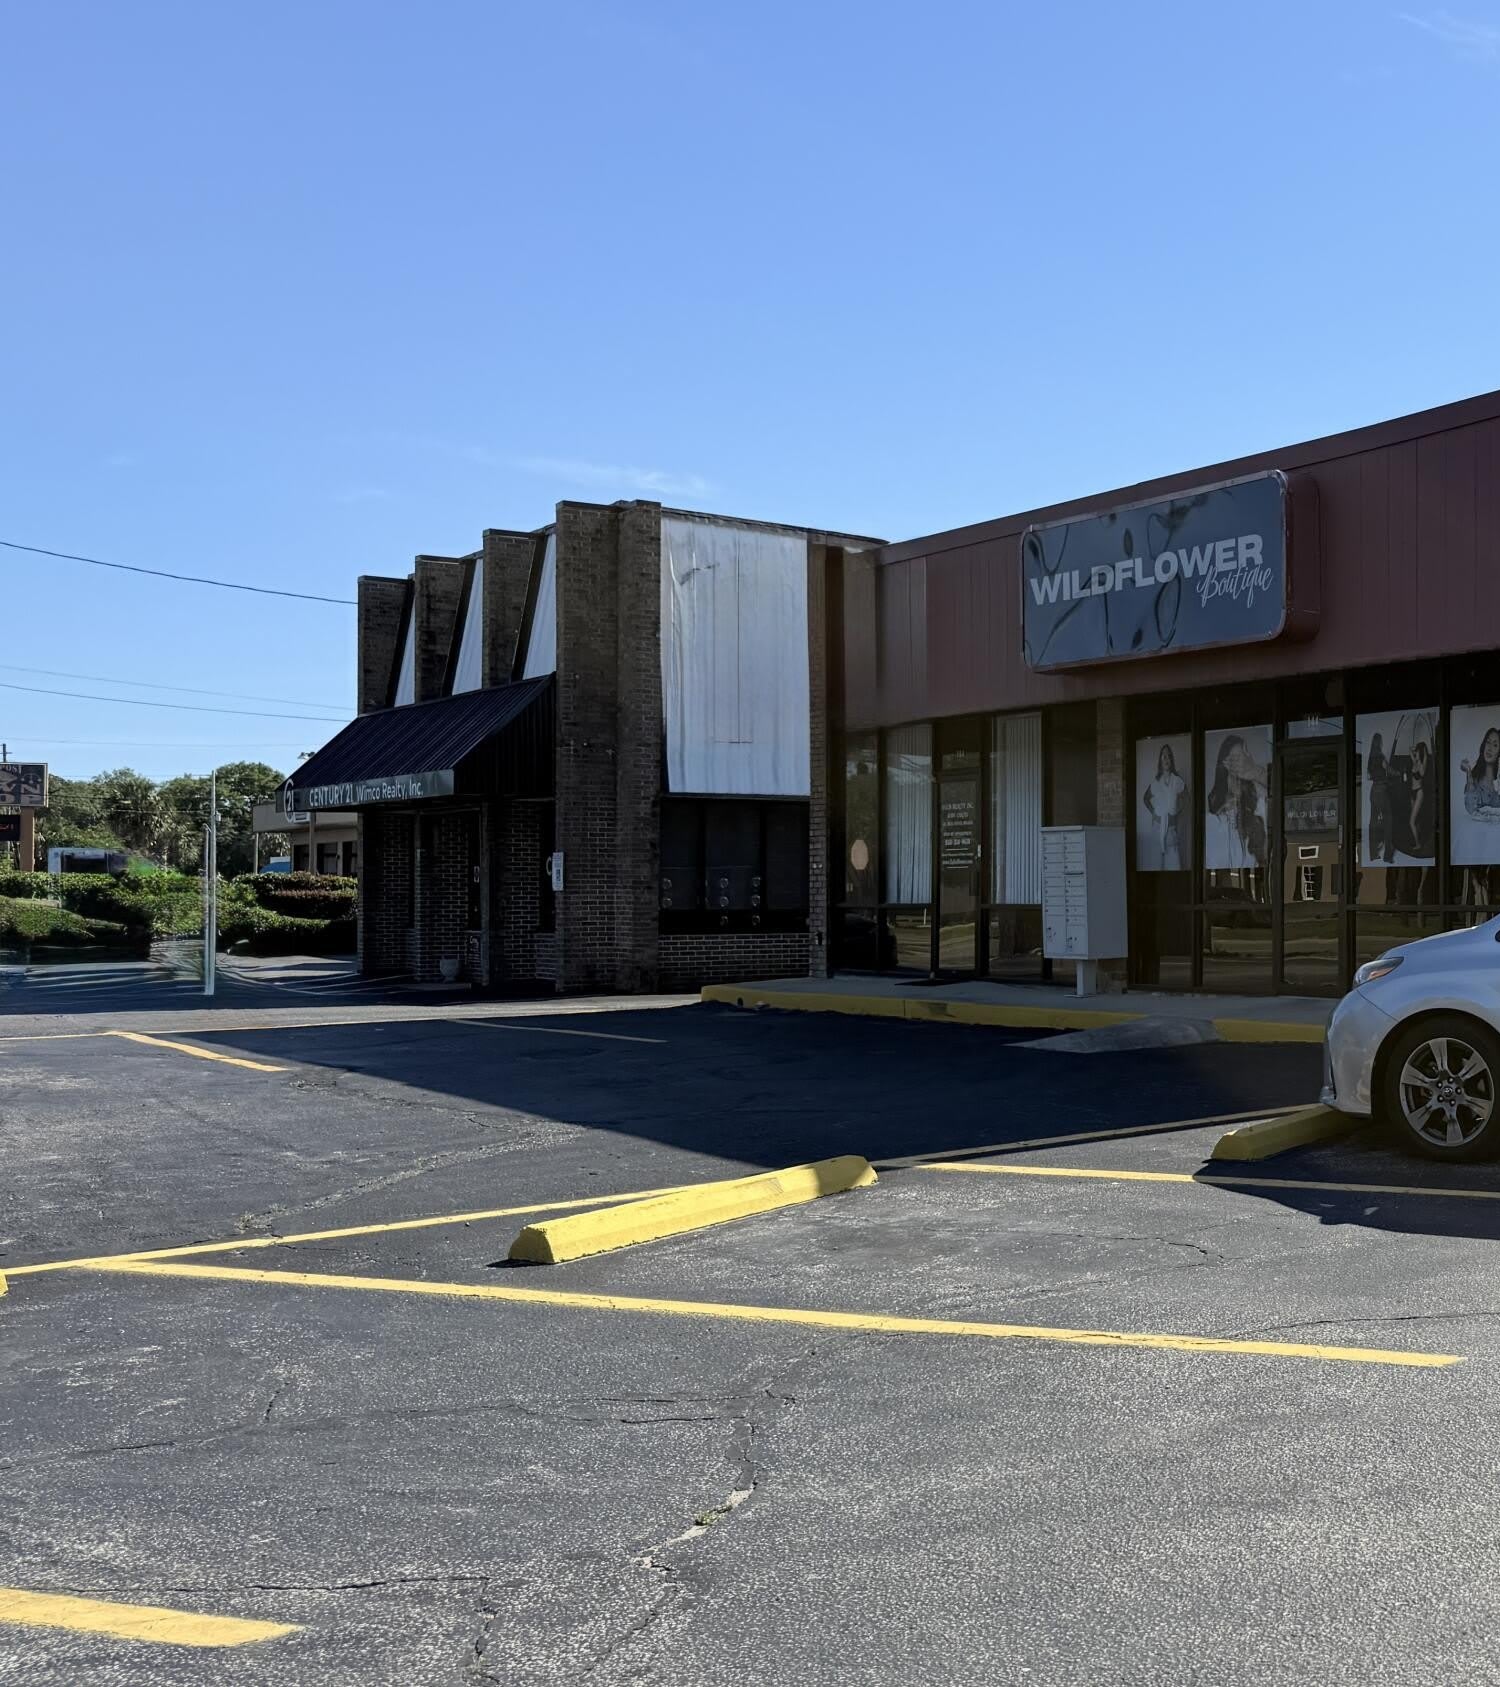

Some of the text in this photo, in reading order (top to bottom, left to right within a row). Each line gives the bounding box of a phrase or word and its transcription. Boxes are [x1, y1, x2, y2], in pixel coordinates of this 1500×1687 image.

[1030, 534, 1264, 605] WILDFLOWER
[1197, 564, 1273, 608] Boutique
[309, 784, 344, 807] CENTURY
[345, 783, 353, 803] 21
[356, 785, 380, 803] Wimco
[409, 778, 424, 796] Inc.
